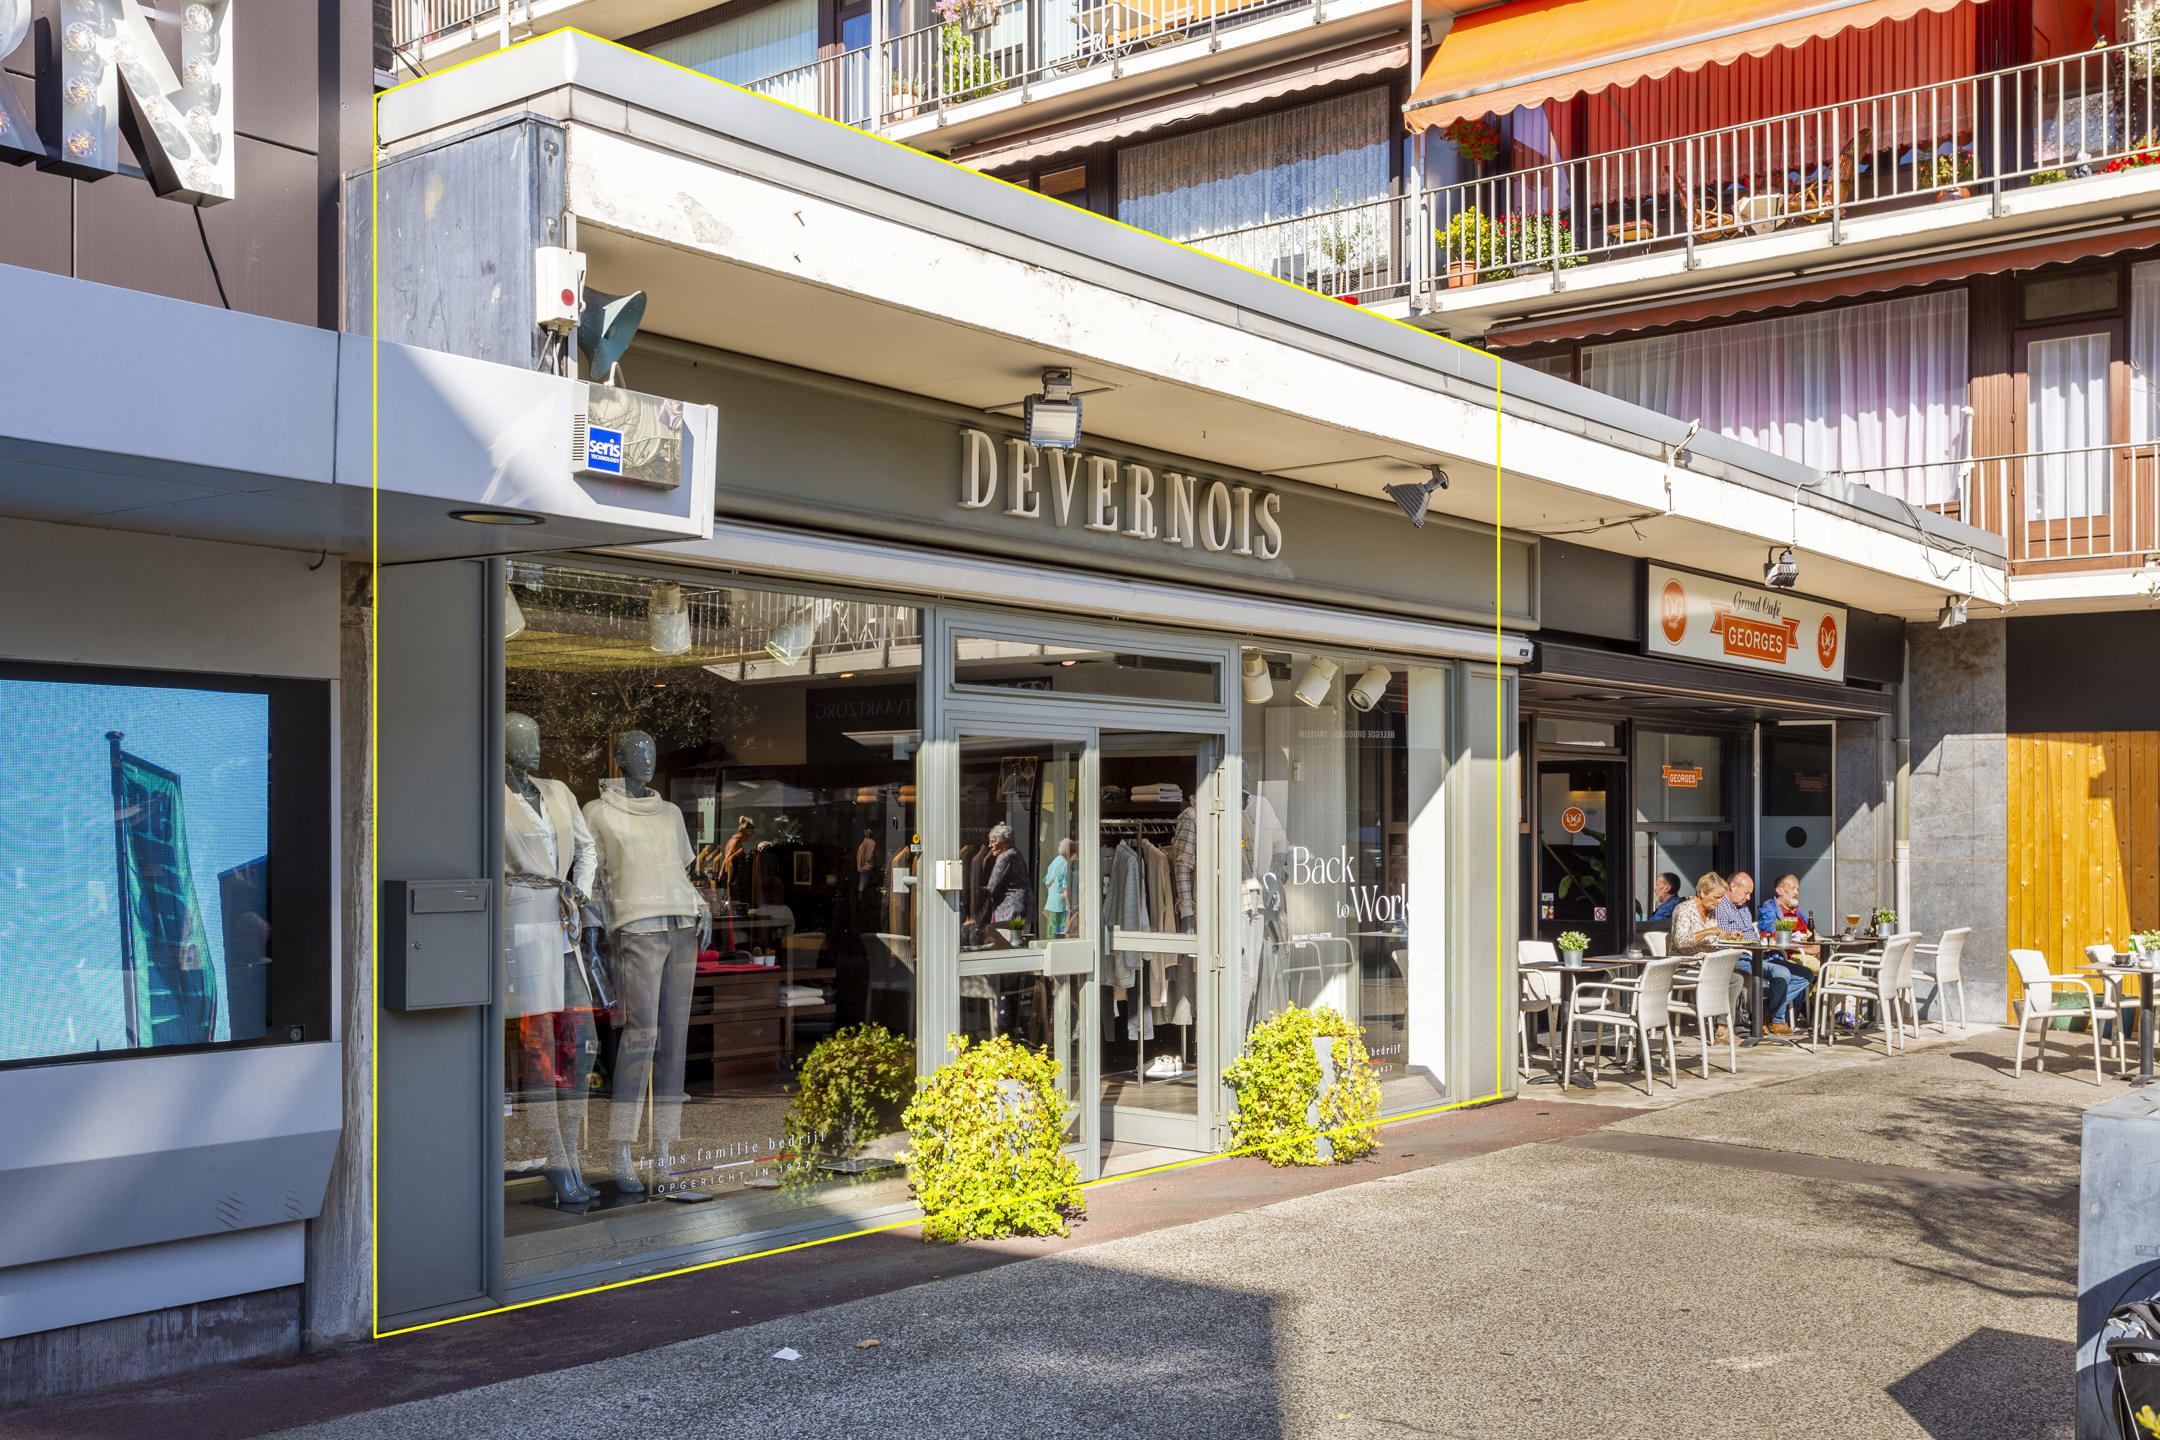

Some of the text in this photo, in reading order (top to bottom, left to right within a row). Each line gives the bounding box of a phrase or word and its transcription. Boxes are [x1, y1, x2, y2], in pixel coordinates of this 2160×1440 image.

[589, 438, 620, 457] seris
[590, 453, 620, 464] TECHNOLOGY
[957, 428, 1282, 560] DEVERNOIS
[1733, 591, 1782, 619] Grand Café
[1728, 626, 1783, 653] GEORGES
[1670, 773, 1696, 784] GEORGES
[1293, 845, 1355, 885] Back
[1336, 900, 1350, 919] to
[1371, 1044, 1401, 1056] bedrijf
[639, 1130, 826, 1170] frans familie bedrijf
[657, 1160, 811, 1194] OPGERICHT IN 1927
